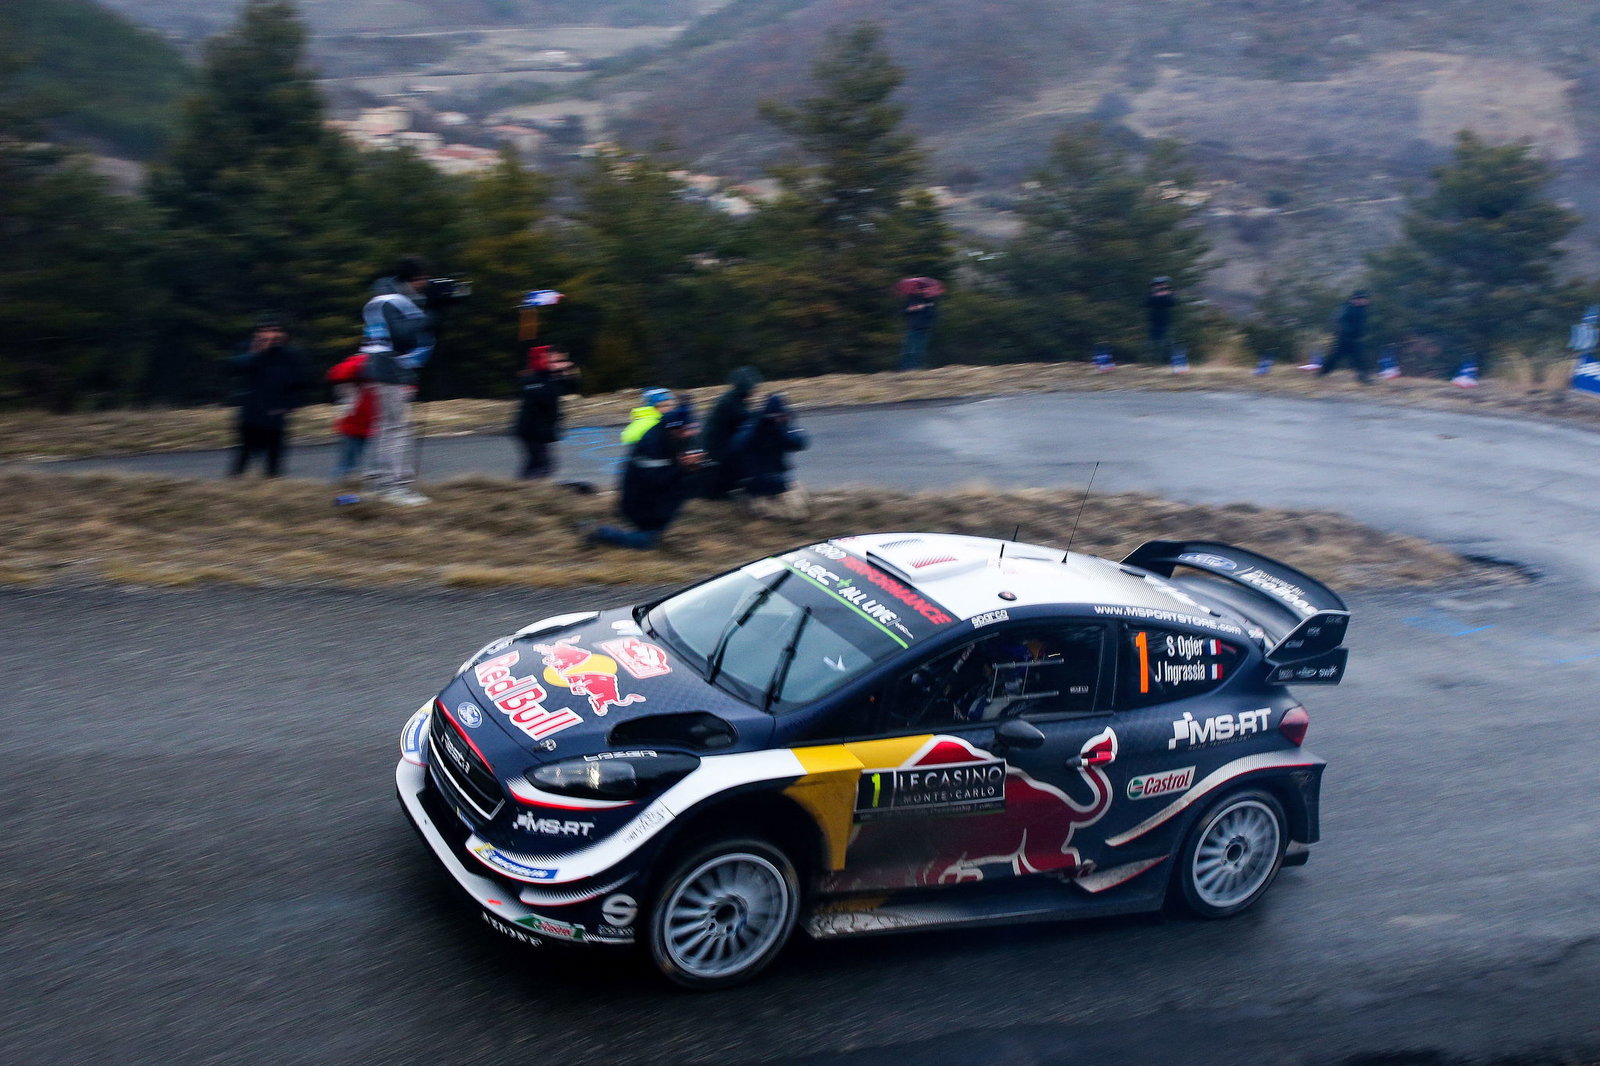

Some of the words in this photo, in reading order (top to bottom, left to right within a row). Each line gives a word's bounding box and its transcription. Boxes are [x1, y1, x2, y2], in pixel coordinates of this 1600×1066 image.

[1166, 635, 1175, 658] S
[1177, 635, 1204, 661] Ogier
[1135, 631, 1150, 694] 1
[1155, 660, 1161, 682] J
[1164, 660, 1205, 686] Ingrassia
[584, 750, 658, 762] LAZER
[871, 773, 881, 807] 1
[925, 766, 1002, 788] CASINO
[1143, 770, 1191, 796] Castrol
